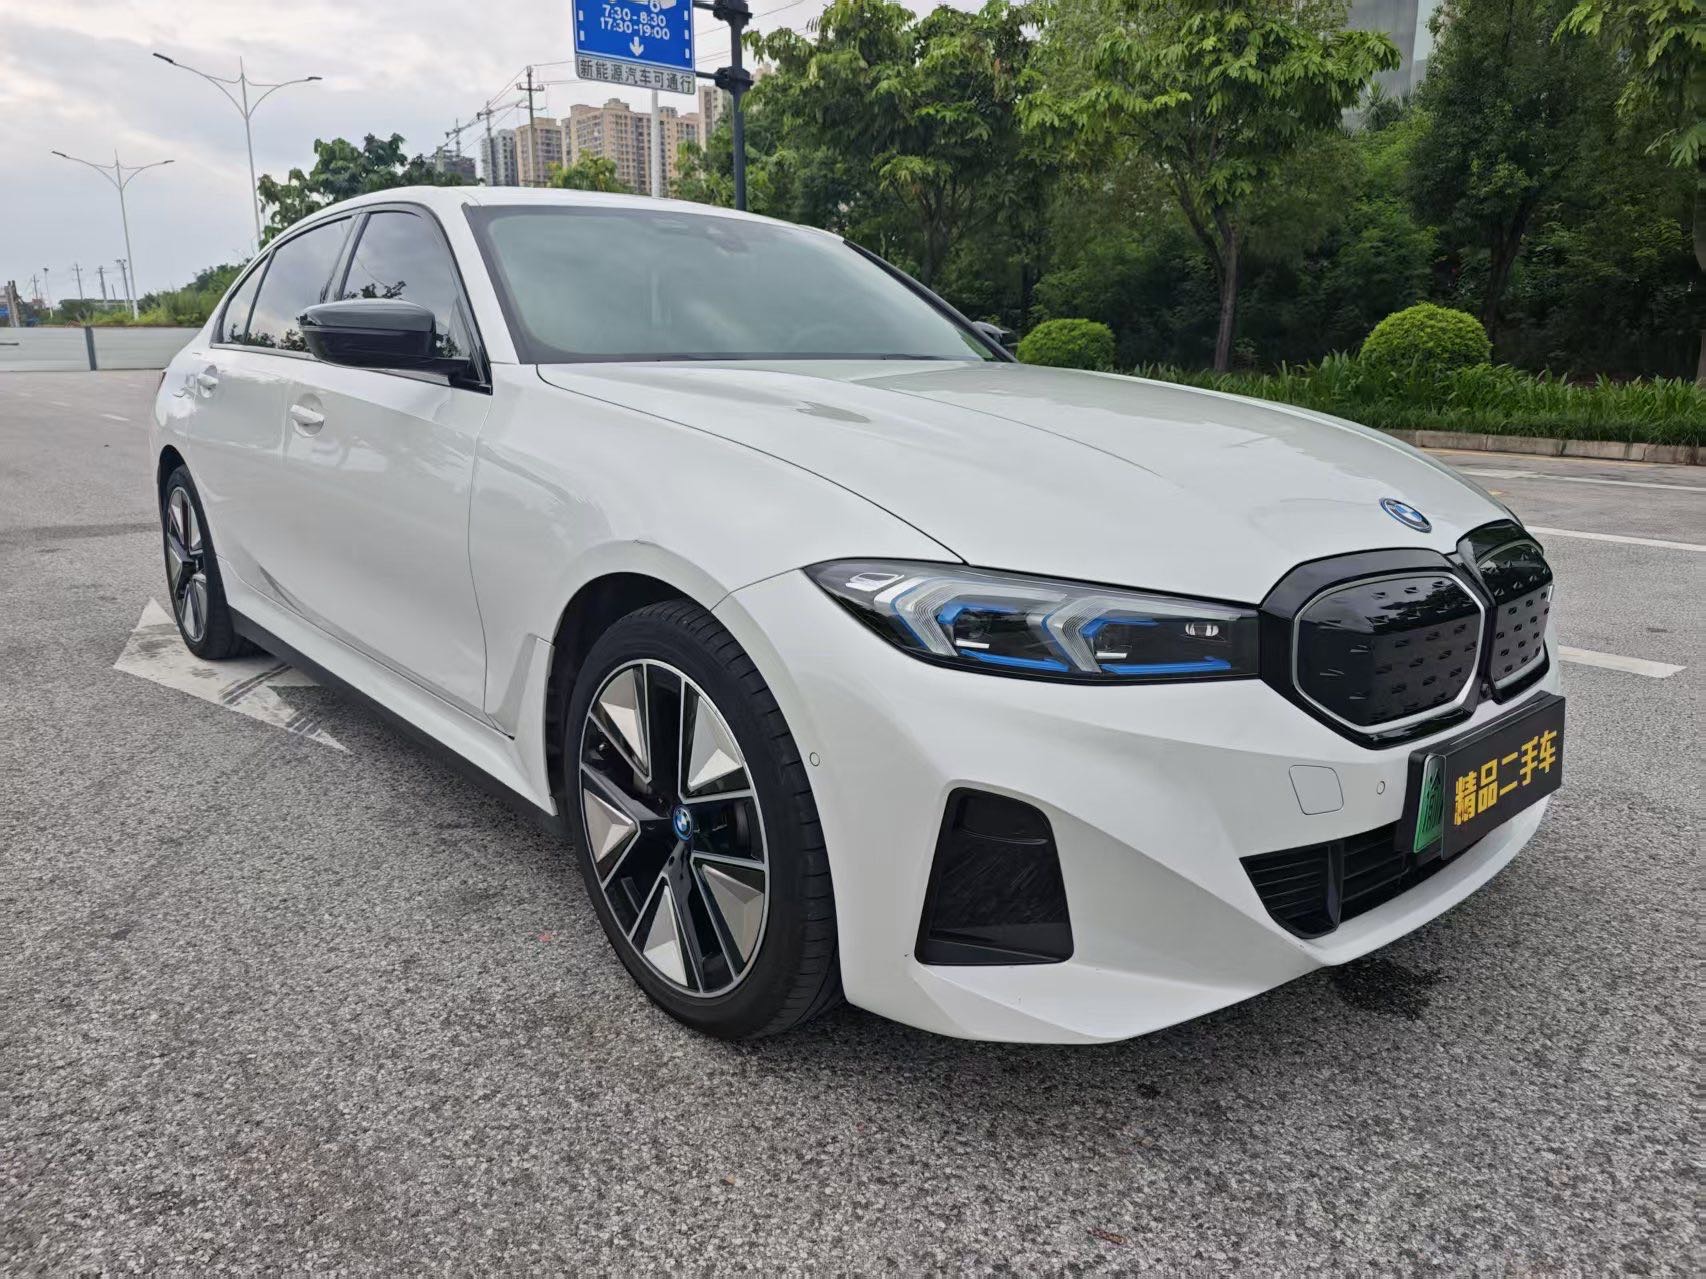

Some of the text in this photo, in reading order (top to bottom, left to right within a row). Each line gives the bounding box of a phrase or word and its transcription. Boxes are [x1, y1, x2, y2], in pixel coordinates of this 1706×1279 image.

[600, 17, 670, 40] 17:30-19:00
[580, 59, 692, 93] 新能源汽车可通行
[1454, 730, 1557, 826] 精品二手车
